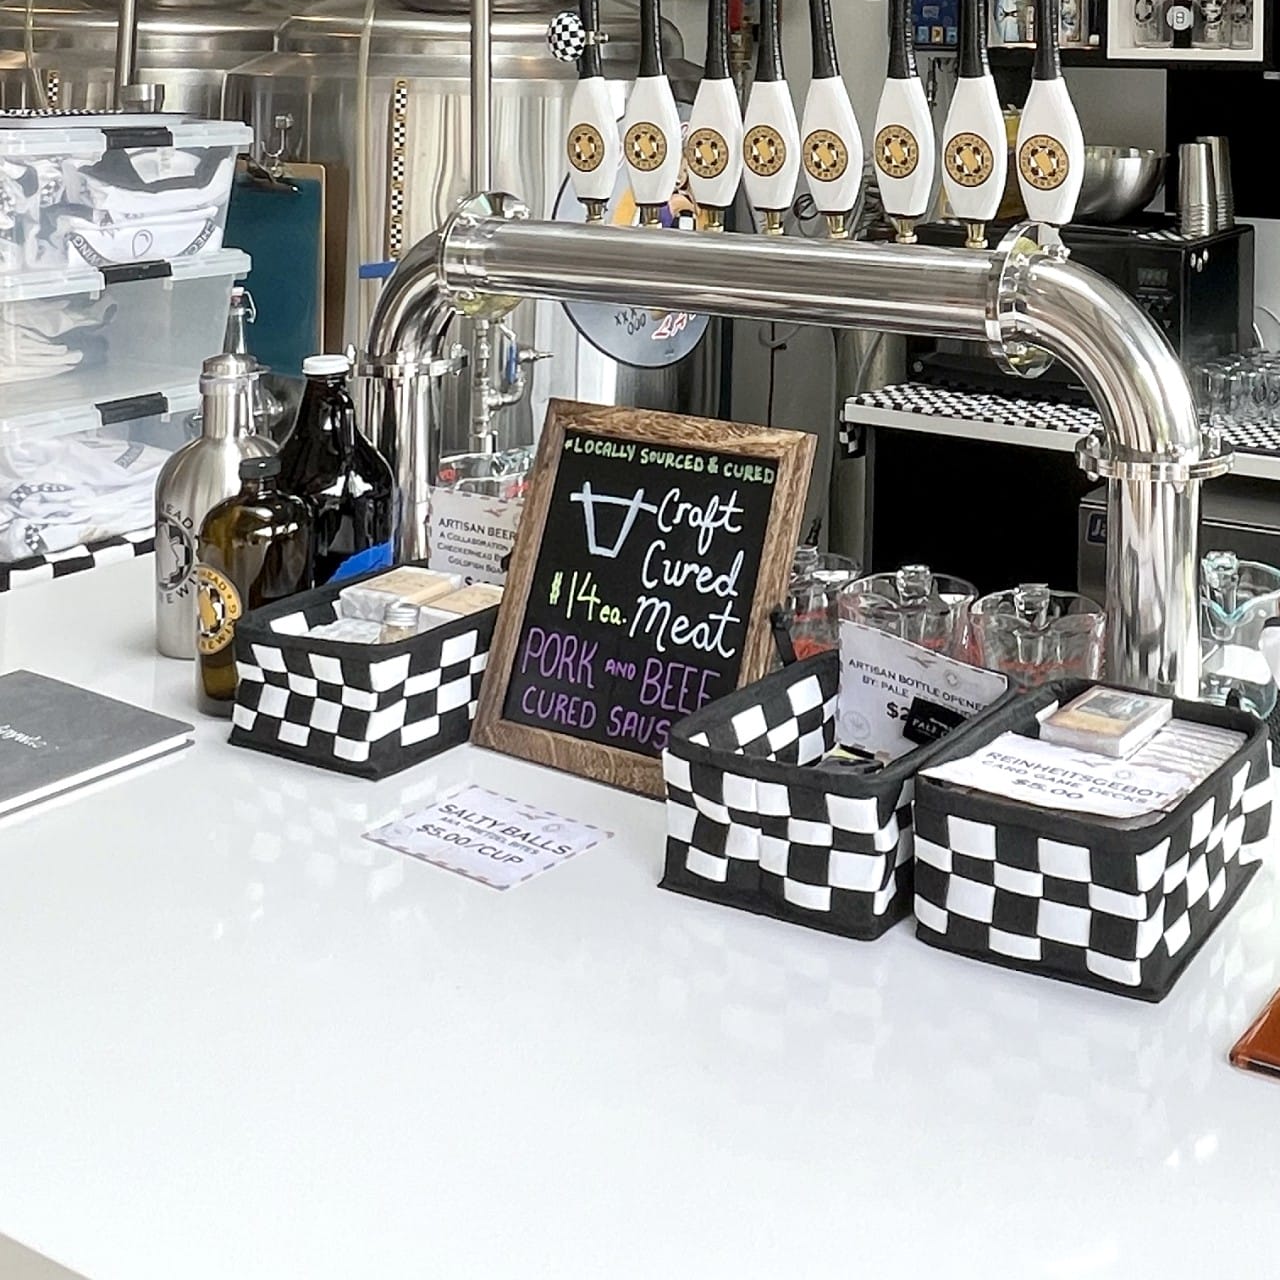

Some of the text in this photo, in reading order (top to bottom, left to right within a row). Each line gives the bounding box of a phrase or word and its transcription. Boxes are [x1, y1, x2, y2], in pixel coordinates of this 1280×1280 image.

[573, 437, 775, 484] LOCALLY SOURCED & CURED
[438, 518, 485, 535] ARTISAN
[657, 488, 744, 556] Craft
[641, 540, 745, 597] Cured
[549, 571, 601, 621] $14
[629, 595, 741, 658] Meat
[521, 627, 721, 716] PORK AND BEEF
[849, 659, 896, 681] ARTISAN
[898, 671, 940, 697] BOTTLE
[881, 681, 909, 698] PALE
[522, 685, 672, 751] CURED SAUS
[980, 760, 1149, 805] CARD GAME DECKS
[985, 751, 1169, 799] REINHEITSGEBOT
[1011, 778, 1084, 800] $5.00
[416, 823, 525, 865] $5.00/CUP
[438, 803, 574, 856] SALTY BALLS
